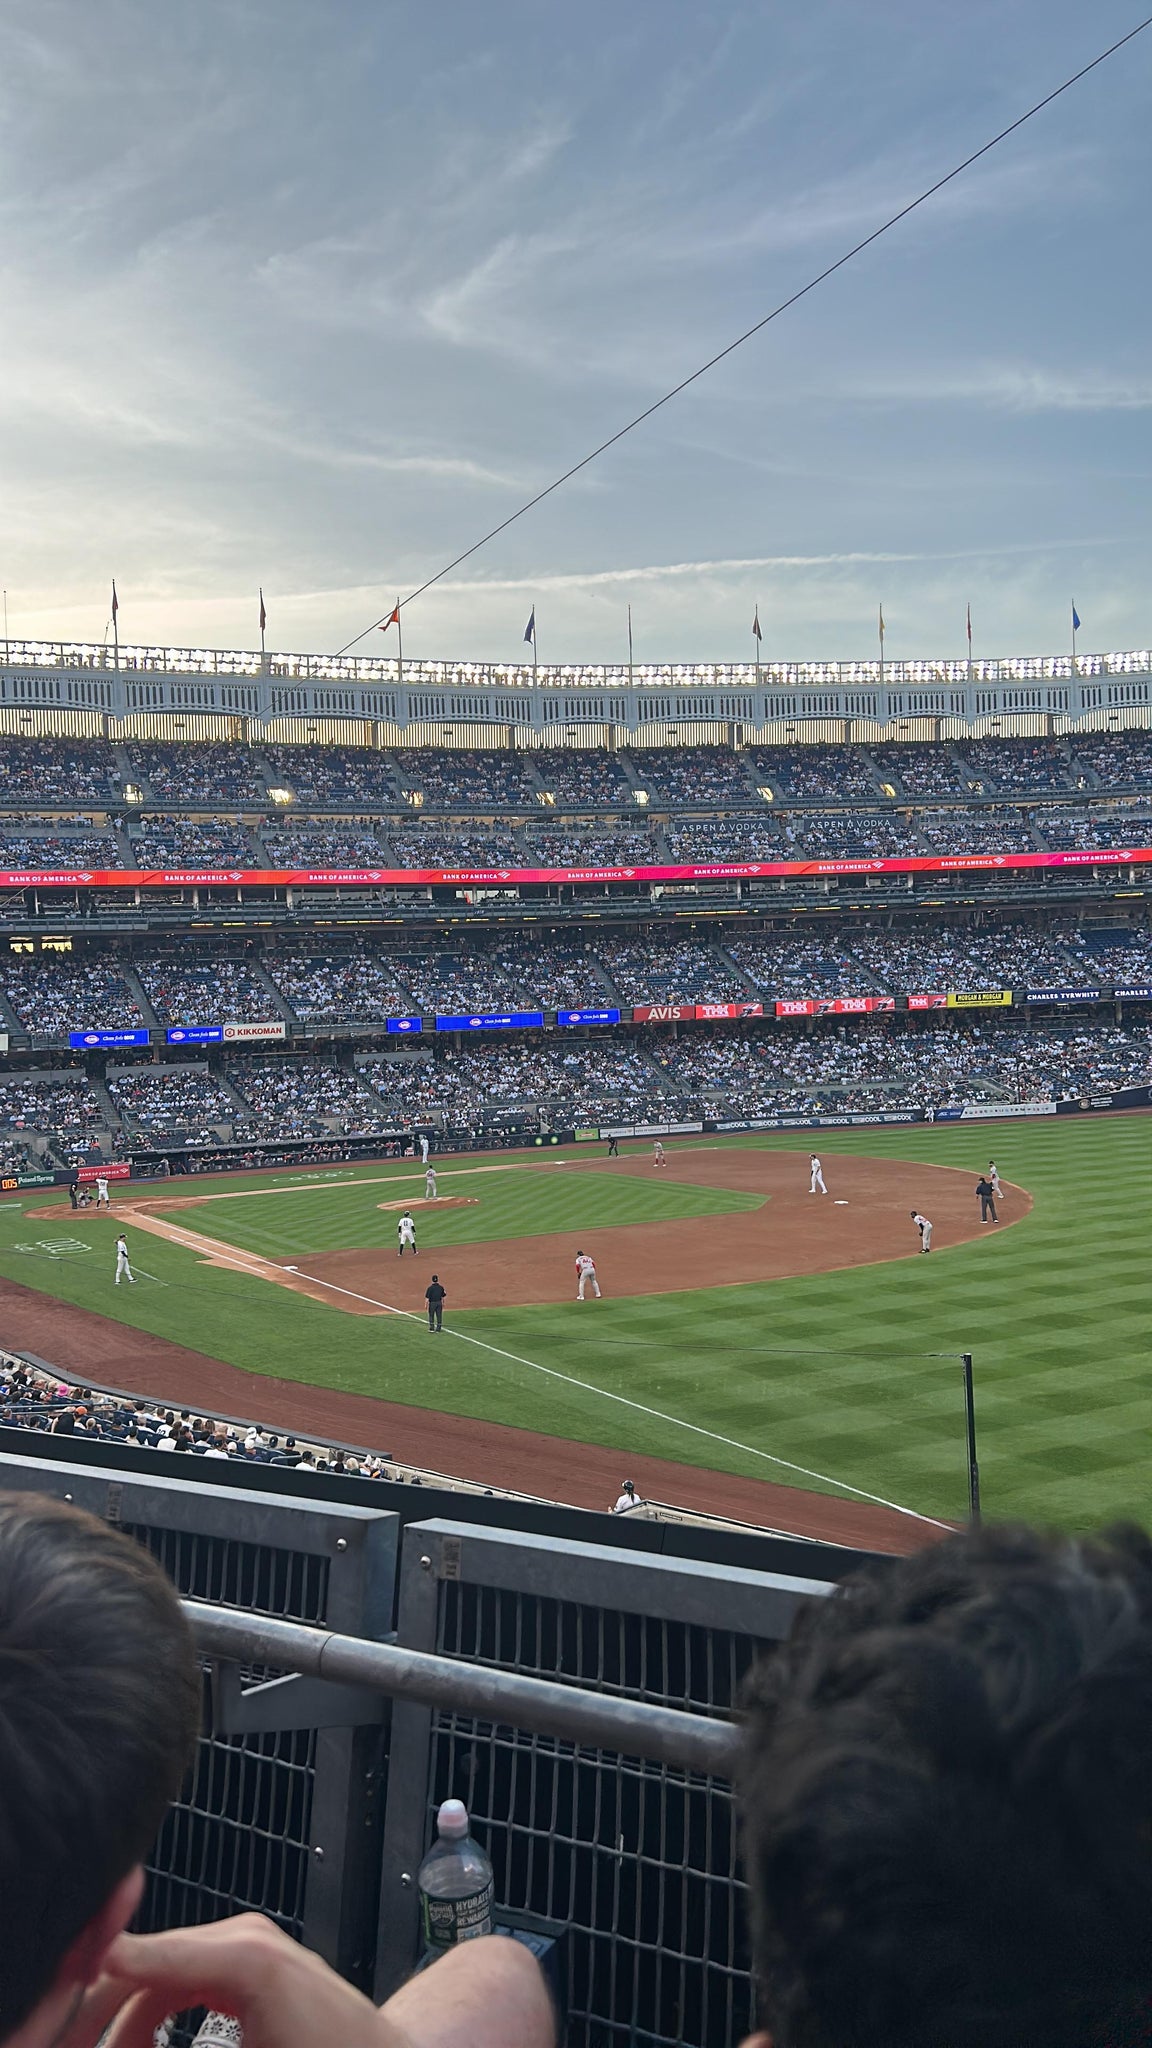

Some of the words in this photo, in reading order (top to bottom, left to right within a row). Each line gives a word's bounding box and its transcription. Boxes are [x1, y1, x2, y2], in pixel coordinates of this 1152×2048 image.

[682, 824, 716, 832] ASPEN
[729, 822, 764, 831] VODKA
[810, 821, 844, 829] ASPEN
[856, 819, 891, 828] VODKA
[1060, 991, 1099, 999] TYRWHITT
[782, 1002, 807, 1012] THK
[841, 999, 866, 1009] THK
[648, 1007, 681, 1020] AVIS
[702, 1005, 729, 1015] THK
[237, 1027, 282, 1035] KIKKOMAN
[36, 1175, 54, 1183] Spring
[456, 1890, 489, 1911] HYDRATE
